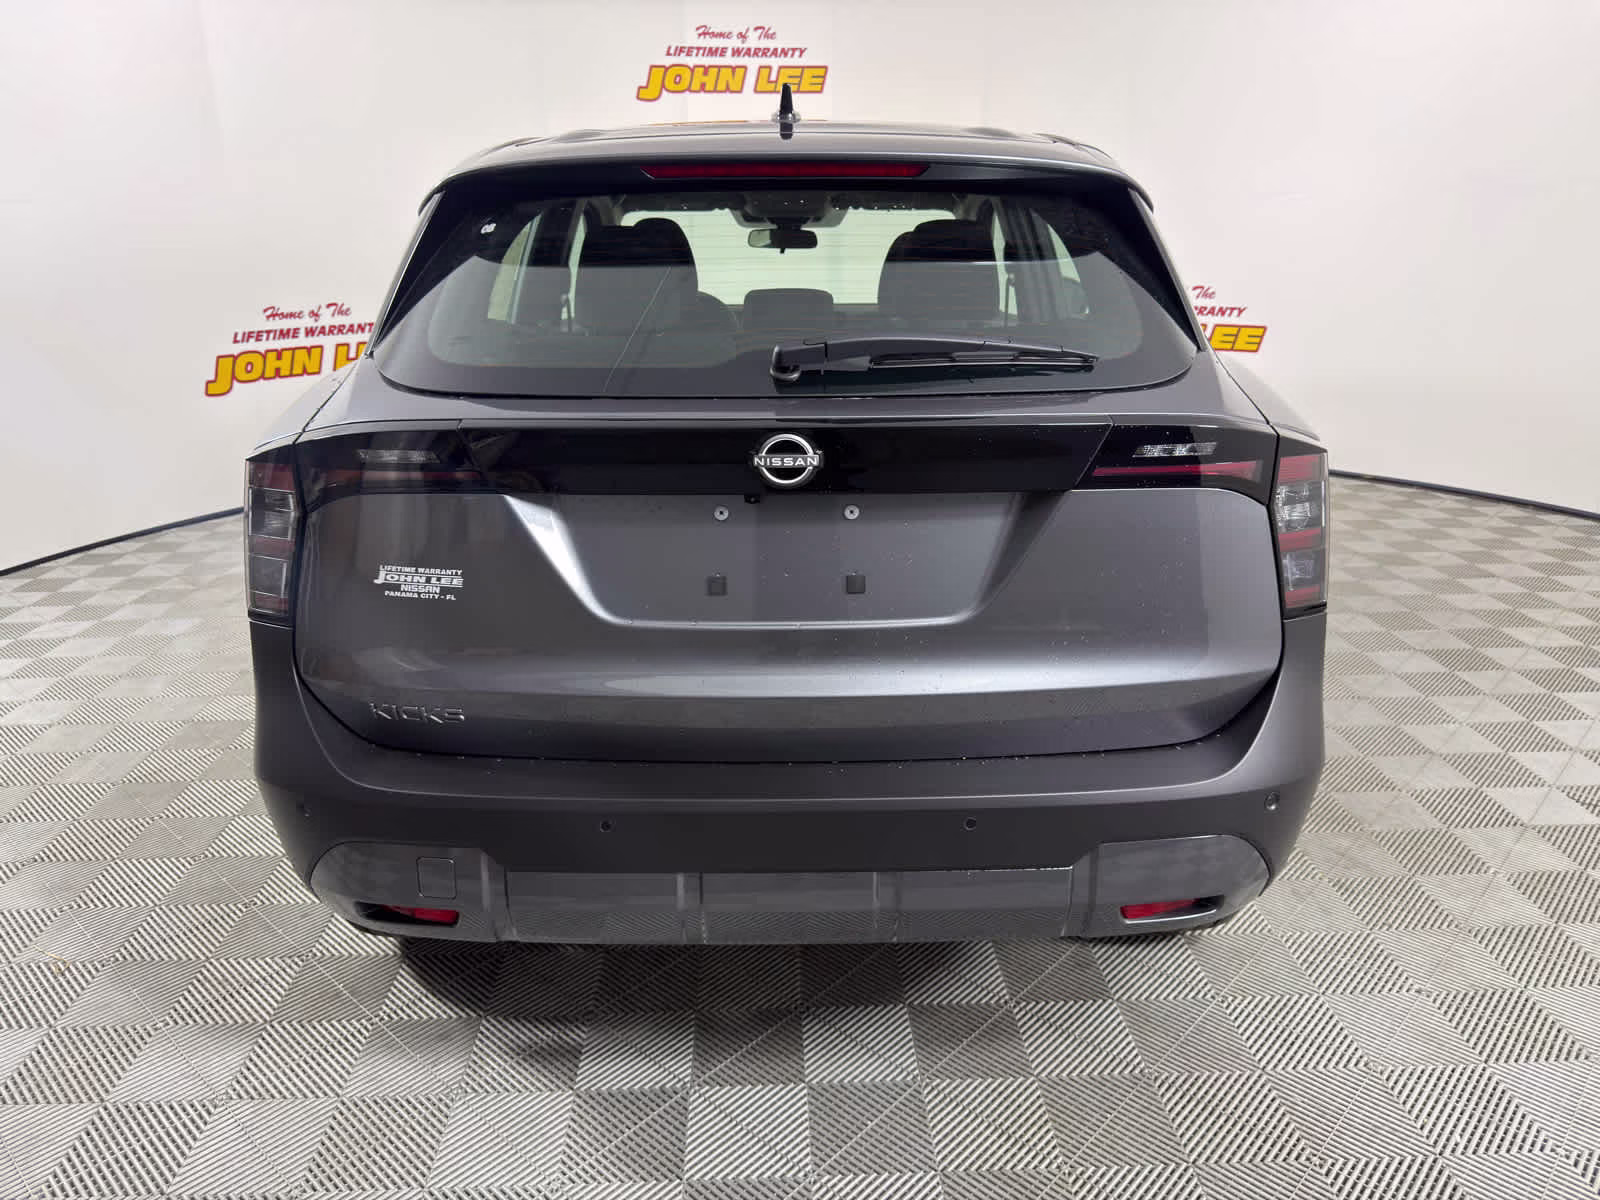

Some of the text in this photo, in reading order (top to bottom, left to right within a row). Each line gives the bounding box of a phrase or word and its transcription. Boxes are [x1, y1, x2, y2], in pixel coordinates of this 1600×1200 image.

[695, 25, 777, 44] Home of The
[665, 46, 808, 58] LIFETIME WARRANTY
[636, 64, 828, 102] JOHN LEE
[1191, 286, 1216, 300] The
[263, 302, 352, 322] Home of The
[232, 322, 375, 344] LIFETIME WARRANT
[1200, 323, 1268, 353] EE
[205, 345, 323, 397] JOHN
[754, 457, 818, 466] NISSAN
[373, 570, 464, 585] JOHN LEE
[379, 564, 463, 575] LIFETIME WARRANTY
[384, 590, 418, 598] PANAMA
[400, 584, 441, 593] NISSAN
[369, 703, 465, 723] KICKS
